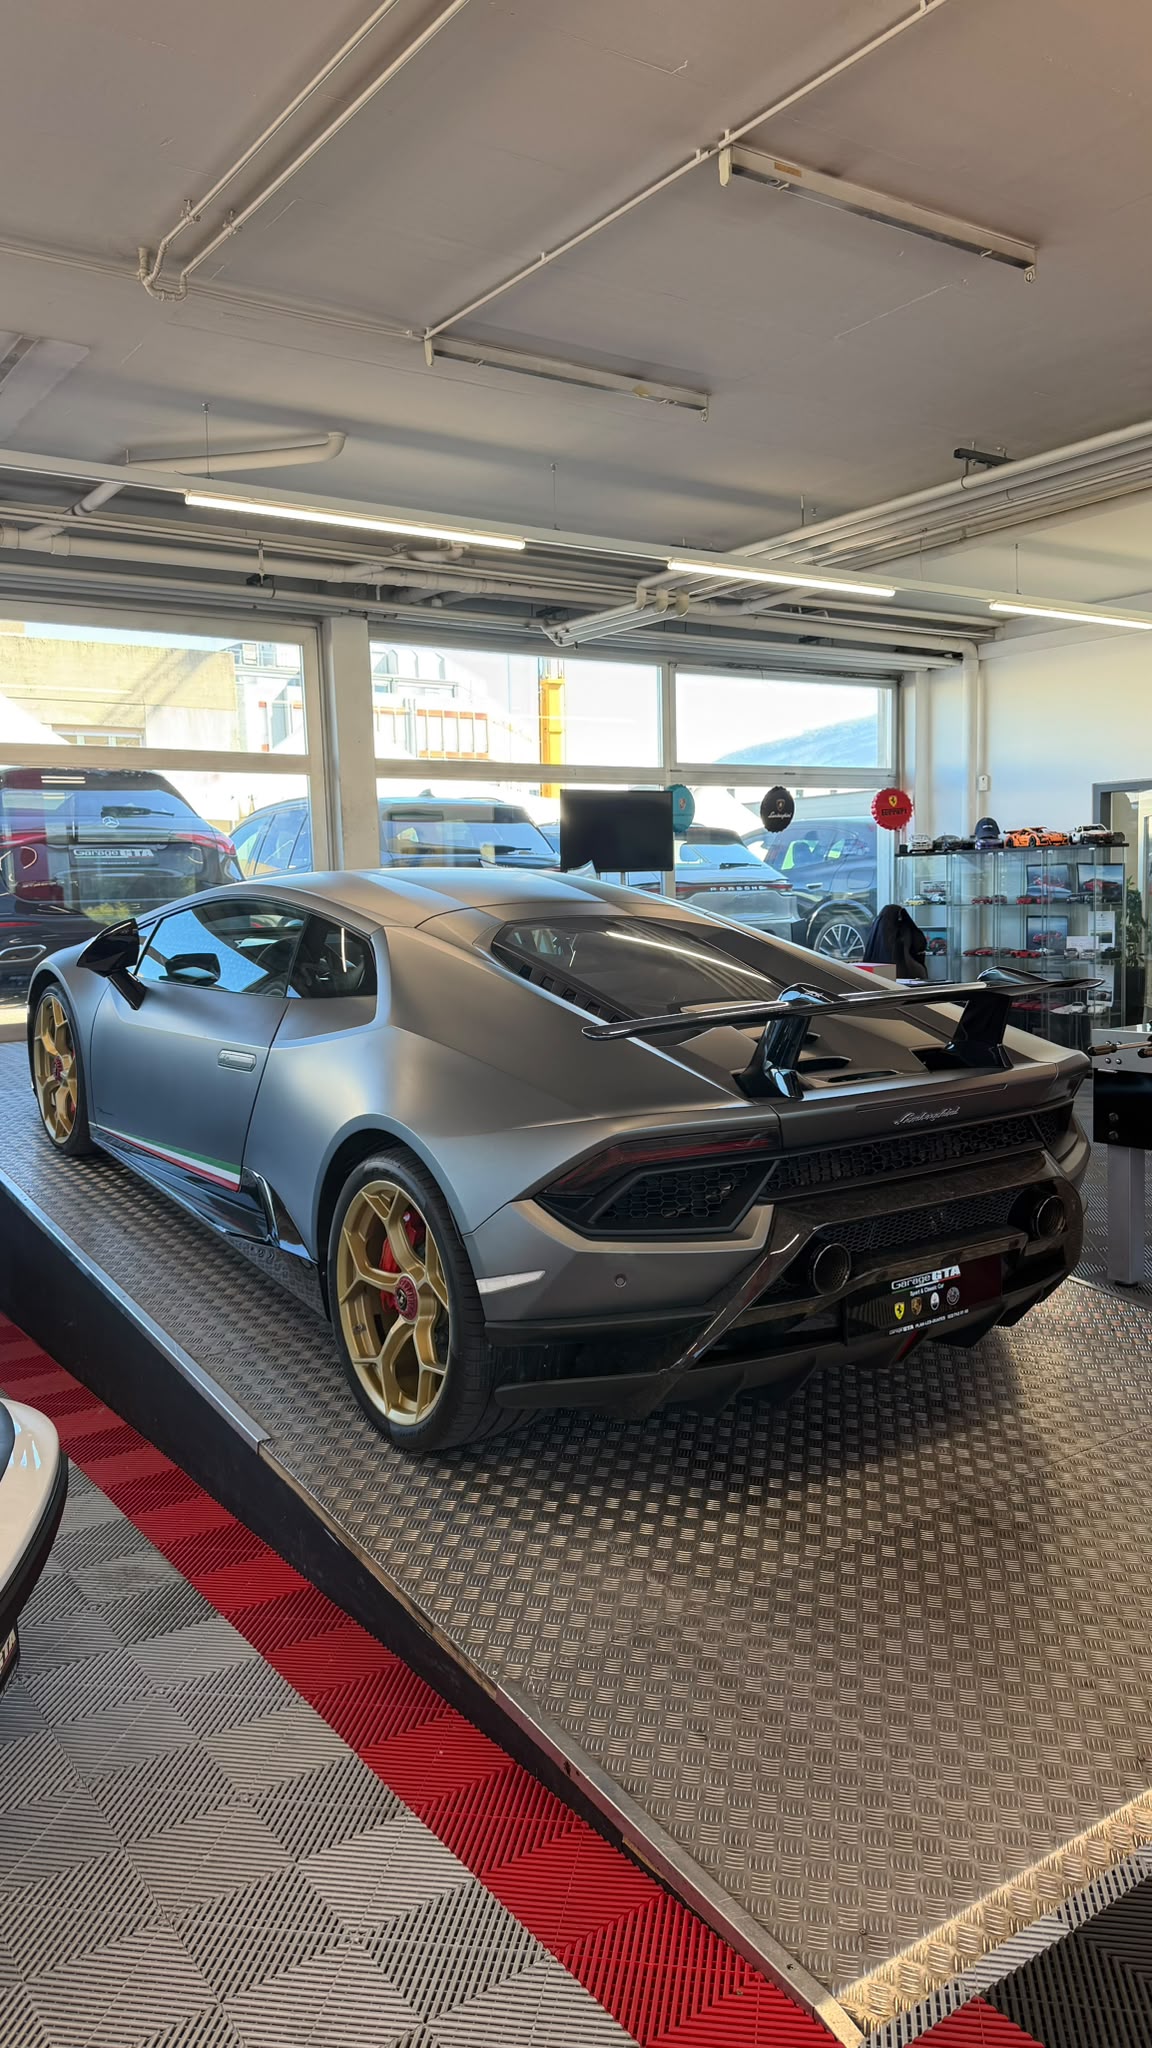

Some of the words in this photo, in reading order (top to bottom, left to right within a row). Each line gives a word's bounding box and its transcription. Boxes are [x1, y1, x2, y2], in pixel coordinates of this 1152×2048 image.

[881, 808, 907, 816] Ferrari
[73, 849, 119, 857] Garage
[893, 1106, 961, 1126] Lamborghini
[891, 1272, 931, 1290] Garage
[931, 1265, 961, 1281] GTA
